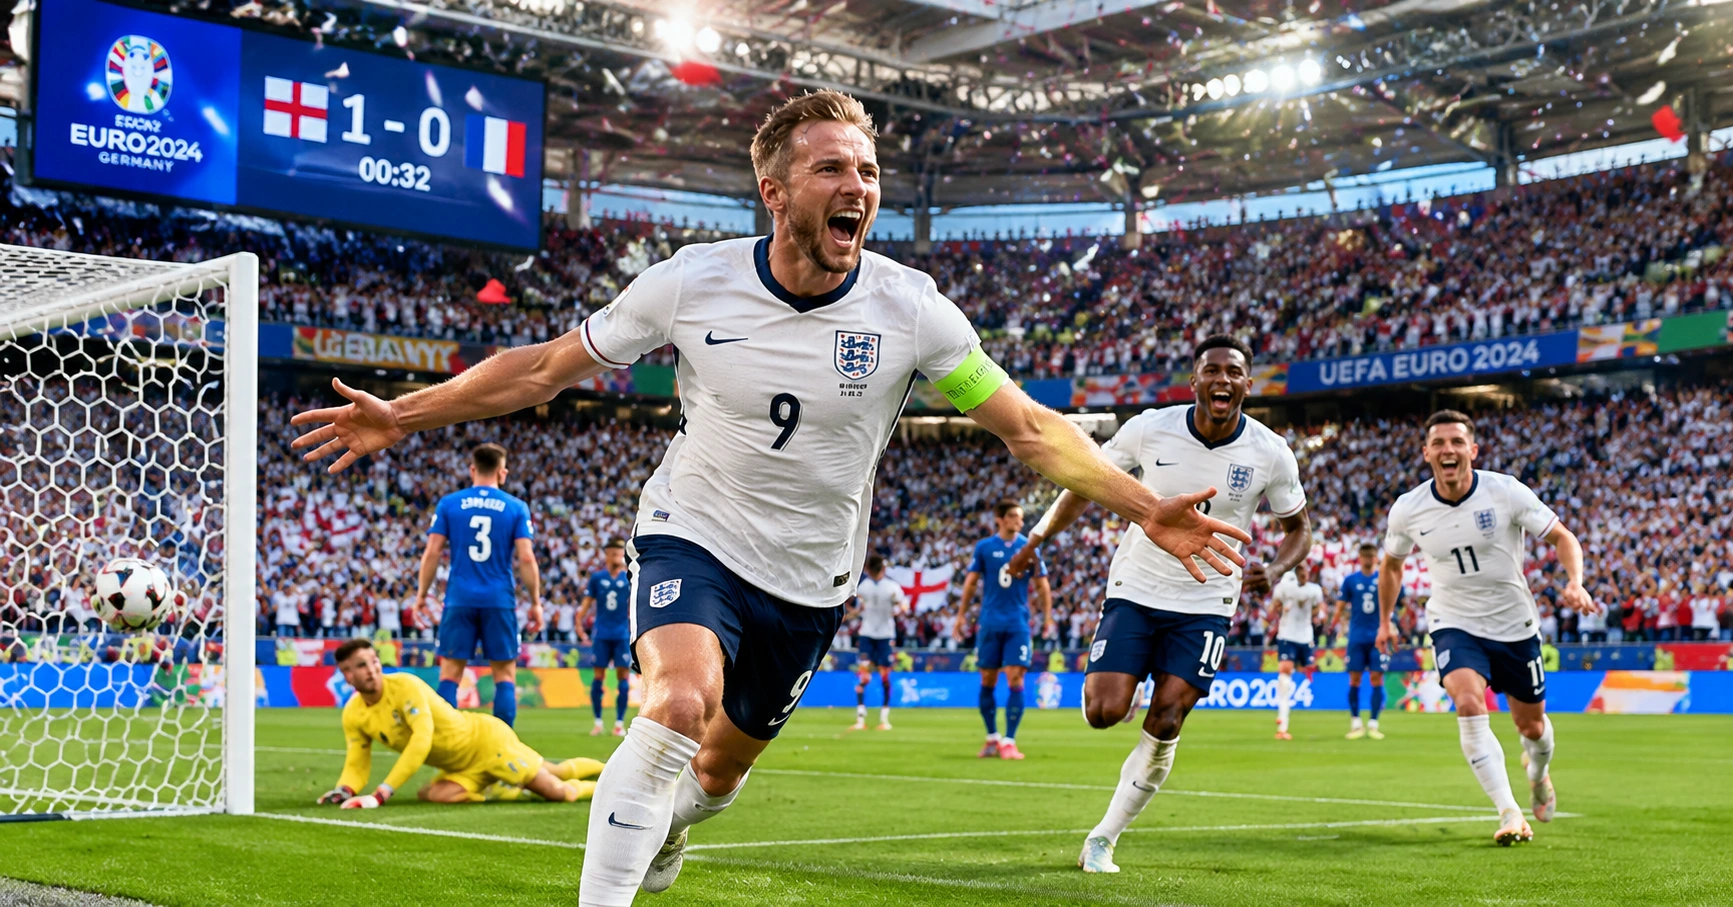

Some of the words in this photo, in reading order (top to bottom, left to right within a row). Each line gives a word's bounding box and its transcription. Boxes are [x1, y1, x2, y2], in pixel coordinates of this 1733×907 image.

[70, 122, 204, 163] EURO2024
[342, 93, 371, 145] 1
[418, 106, 451, 158] 0
[98, 151, 174, 173] GERMANY
[359, 156, 431, 192] 00:32
[1319, 356, 1388, 386] UEFA
[1393, 347, 1469, 379] EURO
[1472, 339, 1541, 371] 2024
[769, 392, 803, 451] 9
[468, 515, 492, 562] 3
[998, 562, 1013, 588] 6
[1451, 545, 1480, 574] 11
[1199, 630, 1226, 671] 10
[1527, 655, 1545, 687] 11
[781, 670, 813, 714] 9
